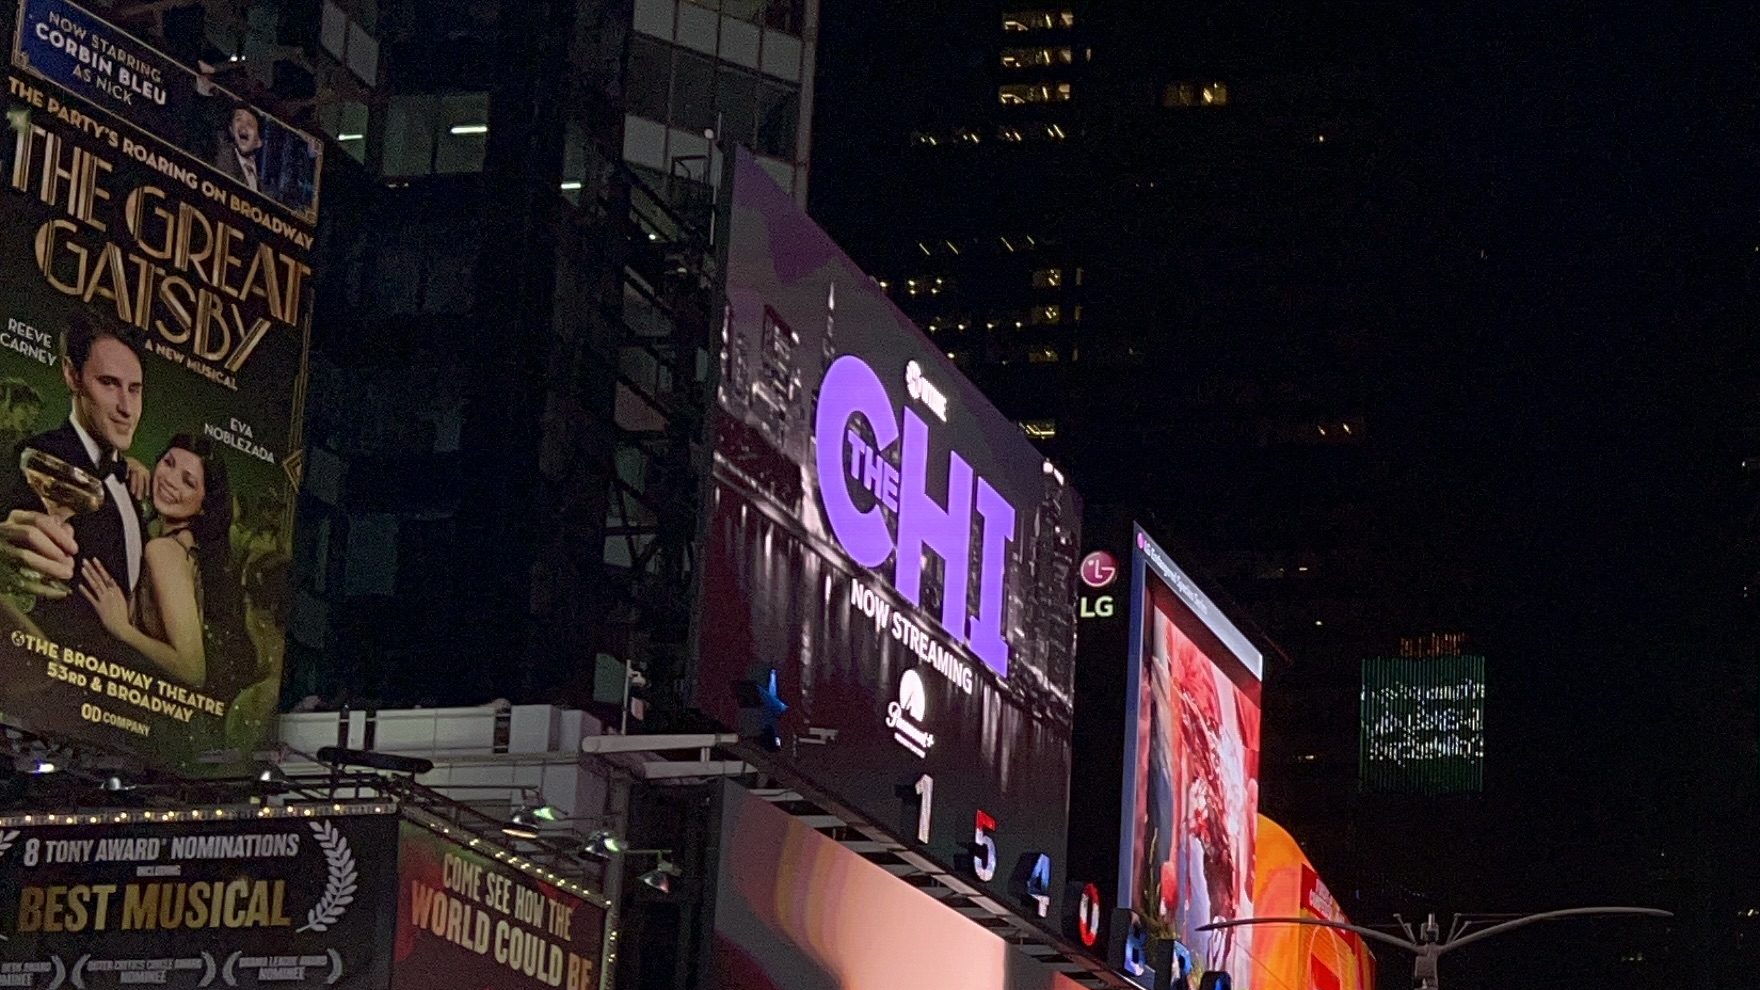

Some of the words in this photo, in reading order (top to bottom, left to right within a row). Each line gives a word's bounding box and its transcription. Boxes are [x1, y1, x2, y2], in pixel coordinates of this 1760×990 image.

[36, 22, 112, 76] CORBIN
[118, 66, 167, 105] BLEU
[49, 11, 87, 40] NOW
[91, 33, 162, 82] STARRING
[72, 64, 92, 84] AS
[95, 76, 133, 105] NICK
[8, 76, 44, 107] THE
[47, 97, 119, 149] PARTY'S
[122, 136, 198, 190] ROARING
[201, 180, 227, 205] ON
[230, 194, 314, 250] BROADWAY
[12, 122, 113, 232] THE
[126, 186, 311, 327] GREAT
[8, 318, 52, 348] REEVE
[35, 219, 272, 372] GATSBY
[156, 342, 181, 363] NEW
[186, 353, 238, 391] MUSICAL
[204, 423, 275, 464] NOBLEZADA
[230, 417, 253, 439] EVA
[847, 429, 899, 513] THE
[816, 354, 1016, 678] CHI
[850, 578, 889, 633] NOW
[891, 614, 973, 694] STREAMING
[1080, 596, 1114, 619] LG
[25, 634, 59, 659] THE
[63, 648, 153, 690] BROADWAY
[158, 680, 225, 716] THEATRE
[47, 662, 87, 688] 53RD
[90, 676, 102, 692] &
[107, 683, 194, 723] BROADWAY
[24, 838, 40, 867] 8
[46, 839, 94, 863] TONY
[171, 833, 299, 859] NOMINATIONS
[17, 885, 117, 932] BEST
[121, 879, 292, 930] MUSICAL
[412, 880, 490, 955] WORLD
[495, 921, 563, 987] COULD
[444, 853, 482, 901] COME
[485, 872, 511, 915] SEE
[515, 885, 545, 928] HOW
[548, 899, 574, 941] THE
